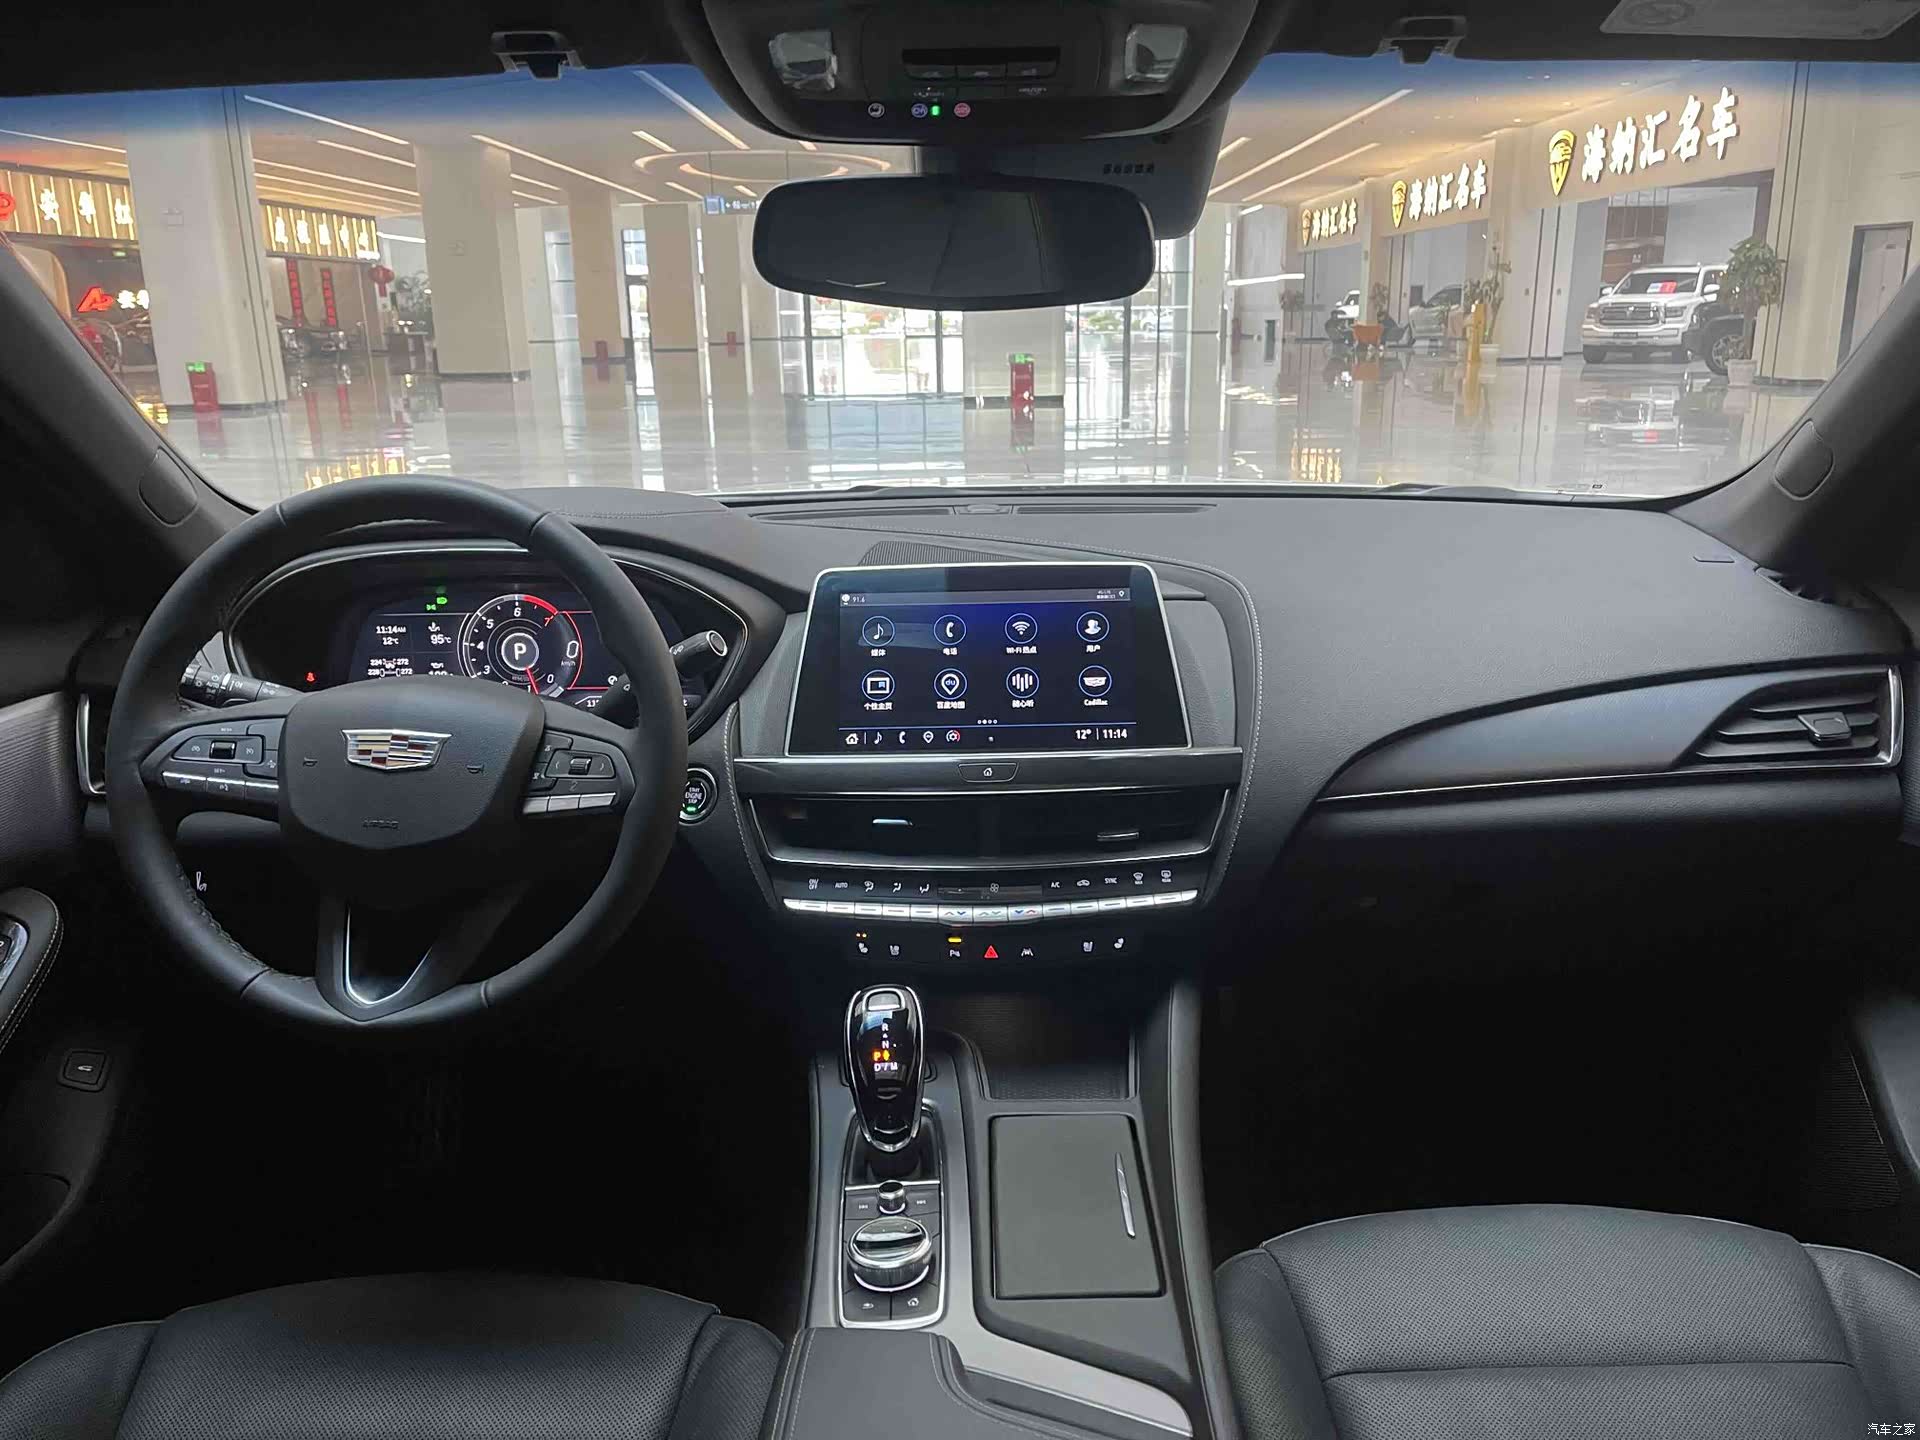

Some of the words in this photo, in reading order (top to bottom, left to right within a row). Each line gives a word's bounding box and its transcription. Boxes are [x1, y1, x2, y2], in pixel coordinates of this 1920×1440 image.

[1582, 86, 1740, 183] 海纳汇名车
[1408, 158, 1487, 221] 海纳汇名车
[513, 607, 521, 617] 6
[486, 619, 494, 629] 5
[544, 617, 552, 627] 7
[476, 641, 484, 650] 4
[566, 640, 579, 658] 0
[1086, 645, 1101, 653] 用户
[513, 643, 527, 660] P
[943, 647, 958, 656] 电话
[483, 665, 491, 674] 3
[546, 674, 554, 683] 0
[1103, 729, 1128, 739] 11:14
[882, 1023, 889, 1031] R
[882, 1040, 889, 1049] N
[873, 1051, 881, 1061] P
